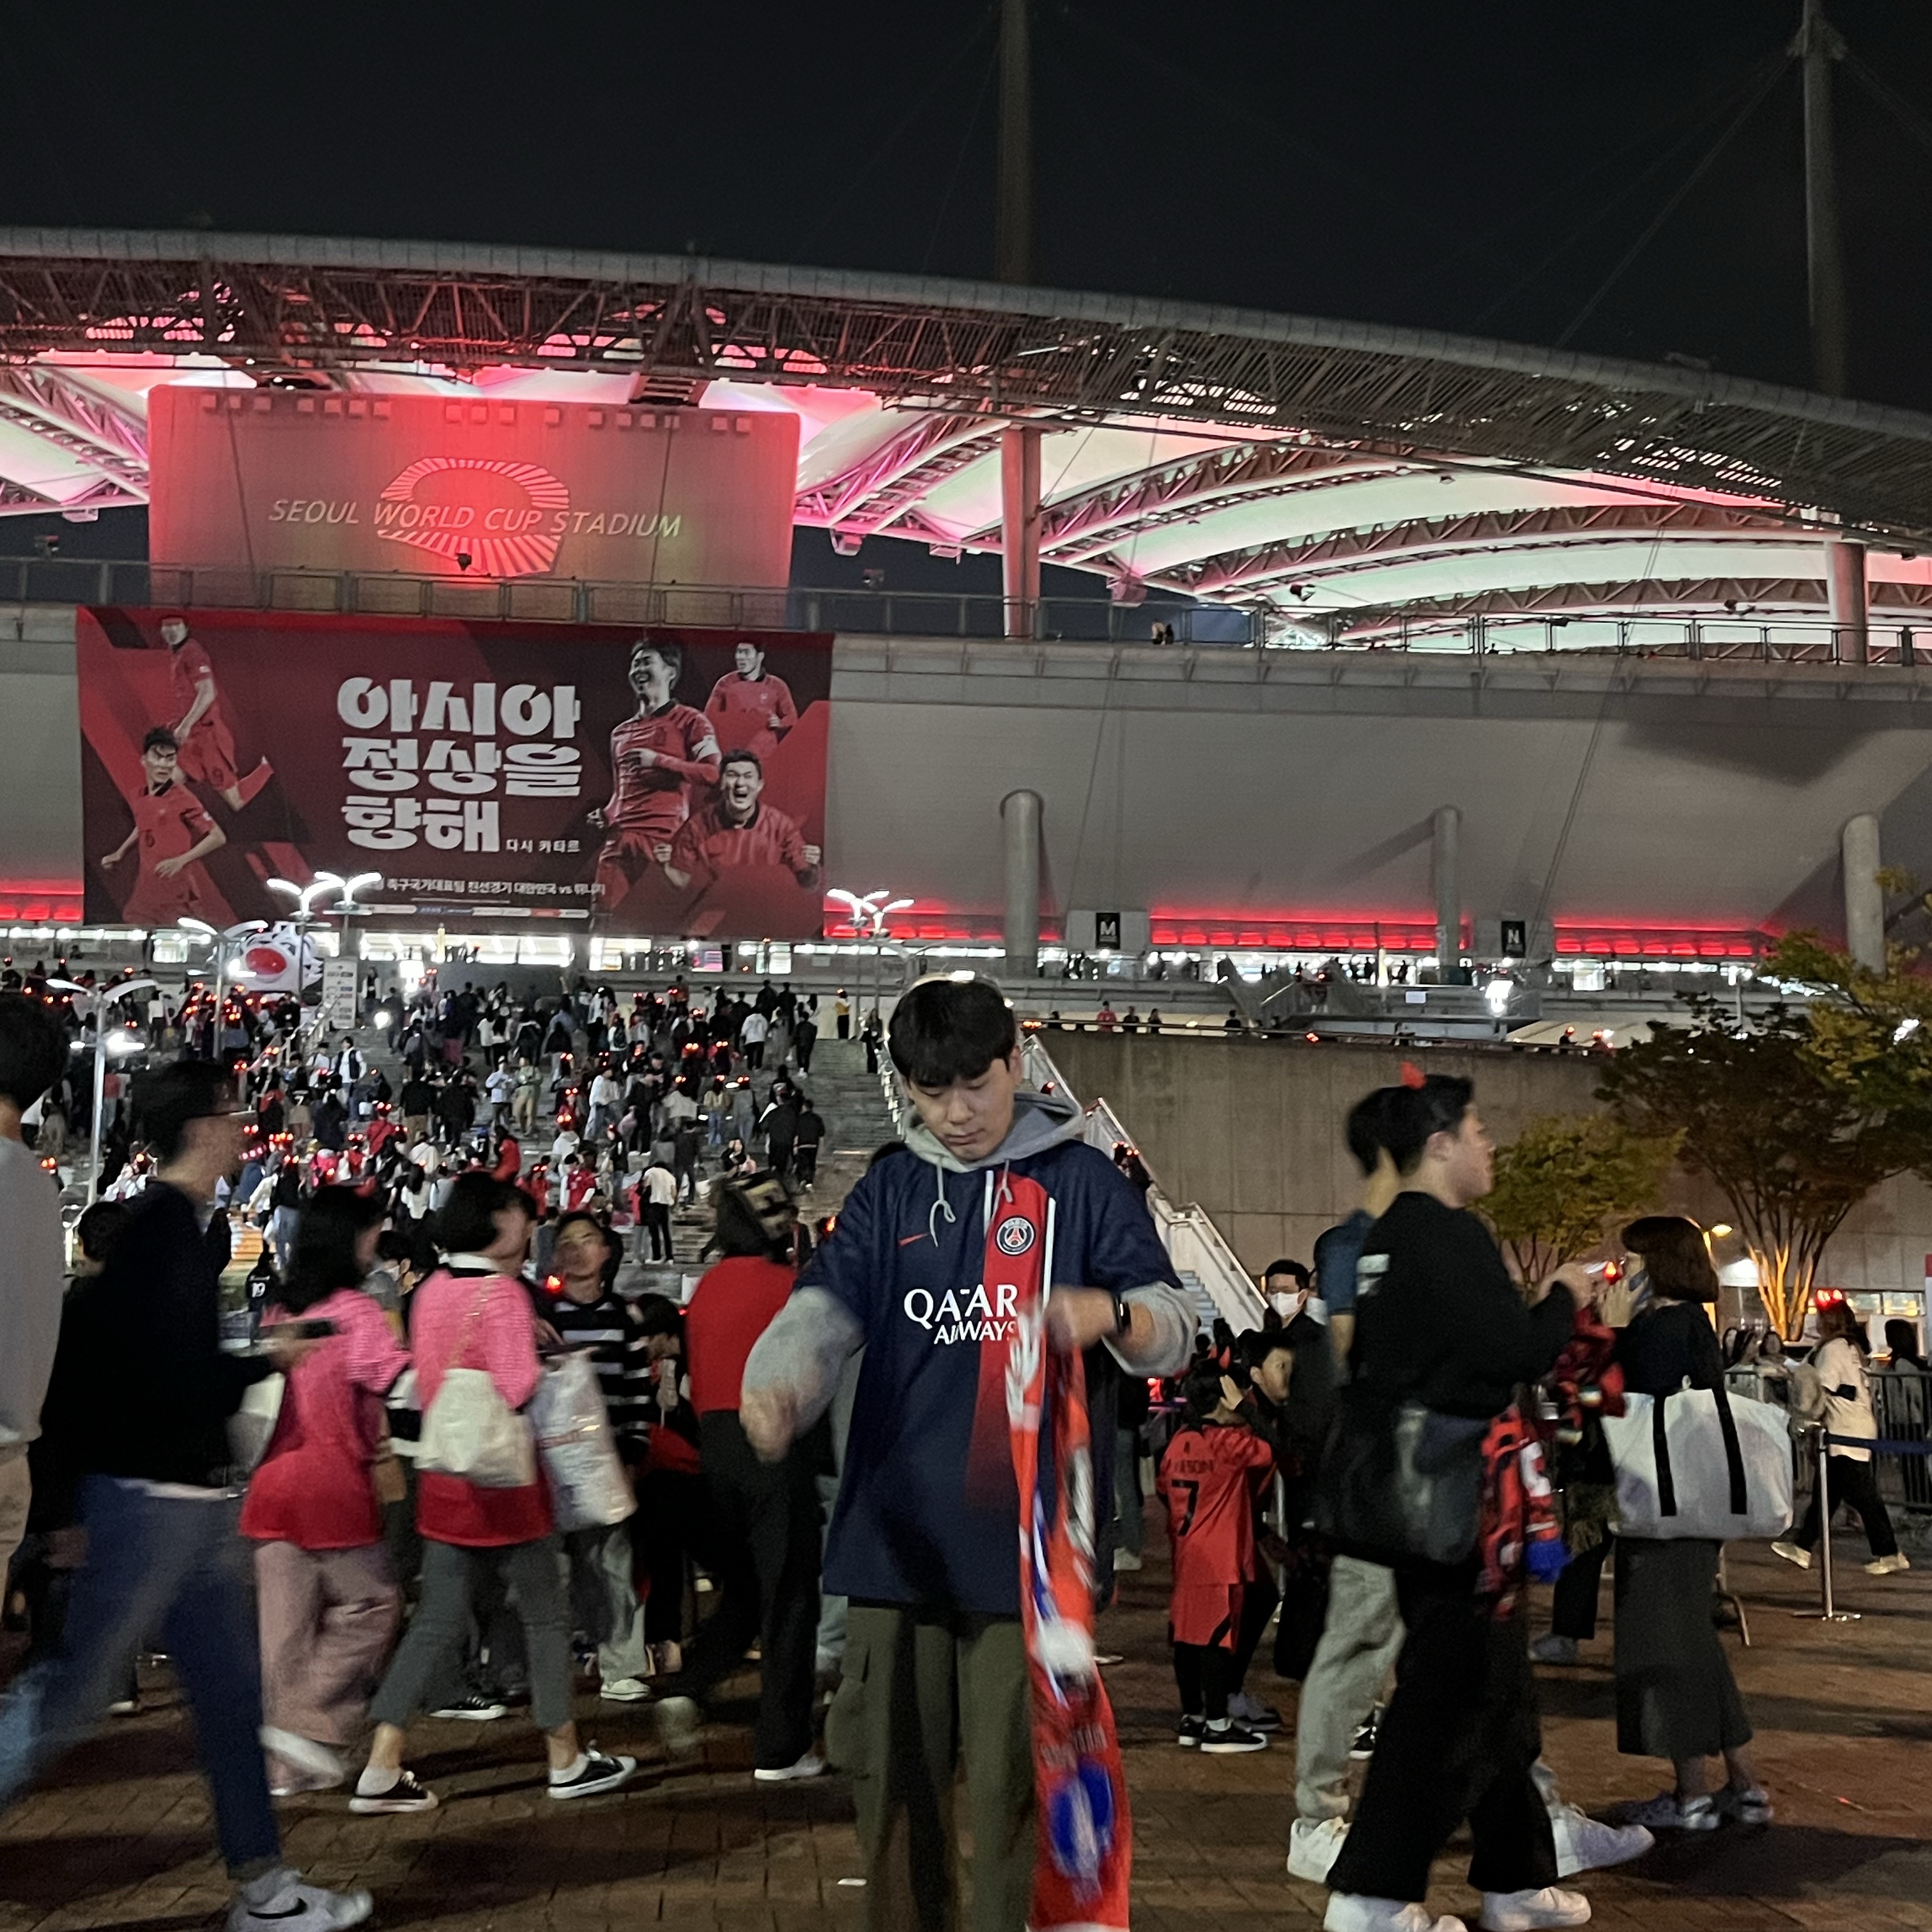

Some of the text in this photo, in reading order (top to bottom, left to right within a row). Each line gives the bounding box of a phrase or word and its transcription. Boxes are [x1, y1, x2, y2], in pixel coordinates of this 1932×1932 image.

[268, 500, 682, 538] SEOUL WORLD CUP STADIUM
[337, 677, 581, 739] 아시아
[342, 737, 582, 797] 정상을
[341, 795, 500, 852] 향해
[505, 839, 580, 853] 다시 카타르
[1100, 921, 1116, 935] M
[1508, 929, 1519, 944] N
[1171, 1479, 1199, 1537] 7
